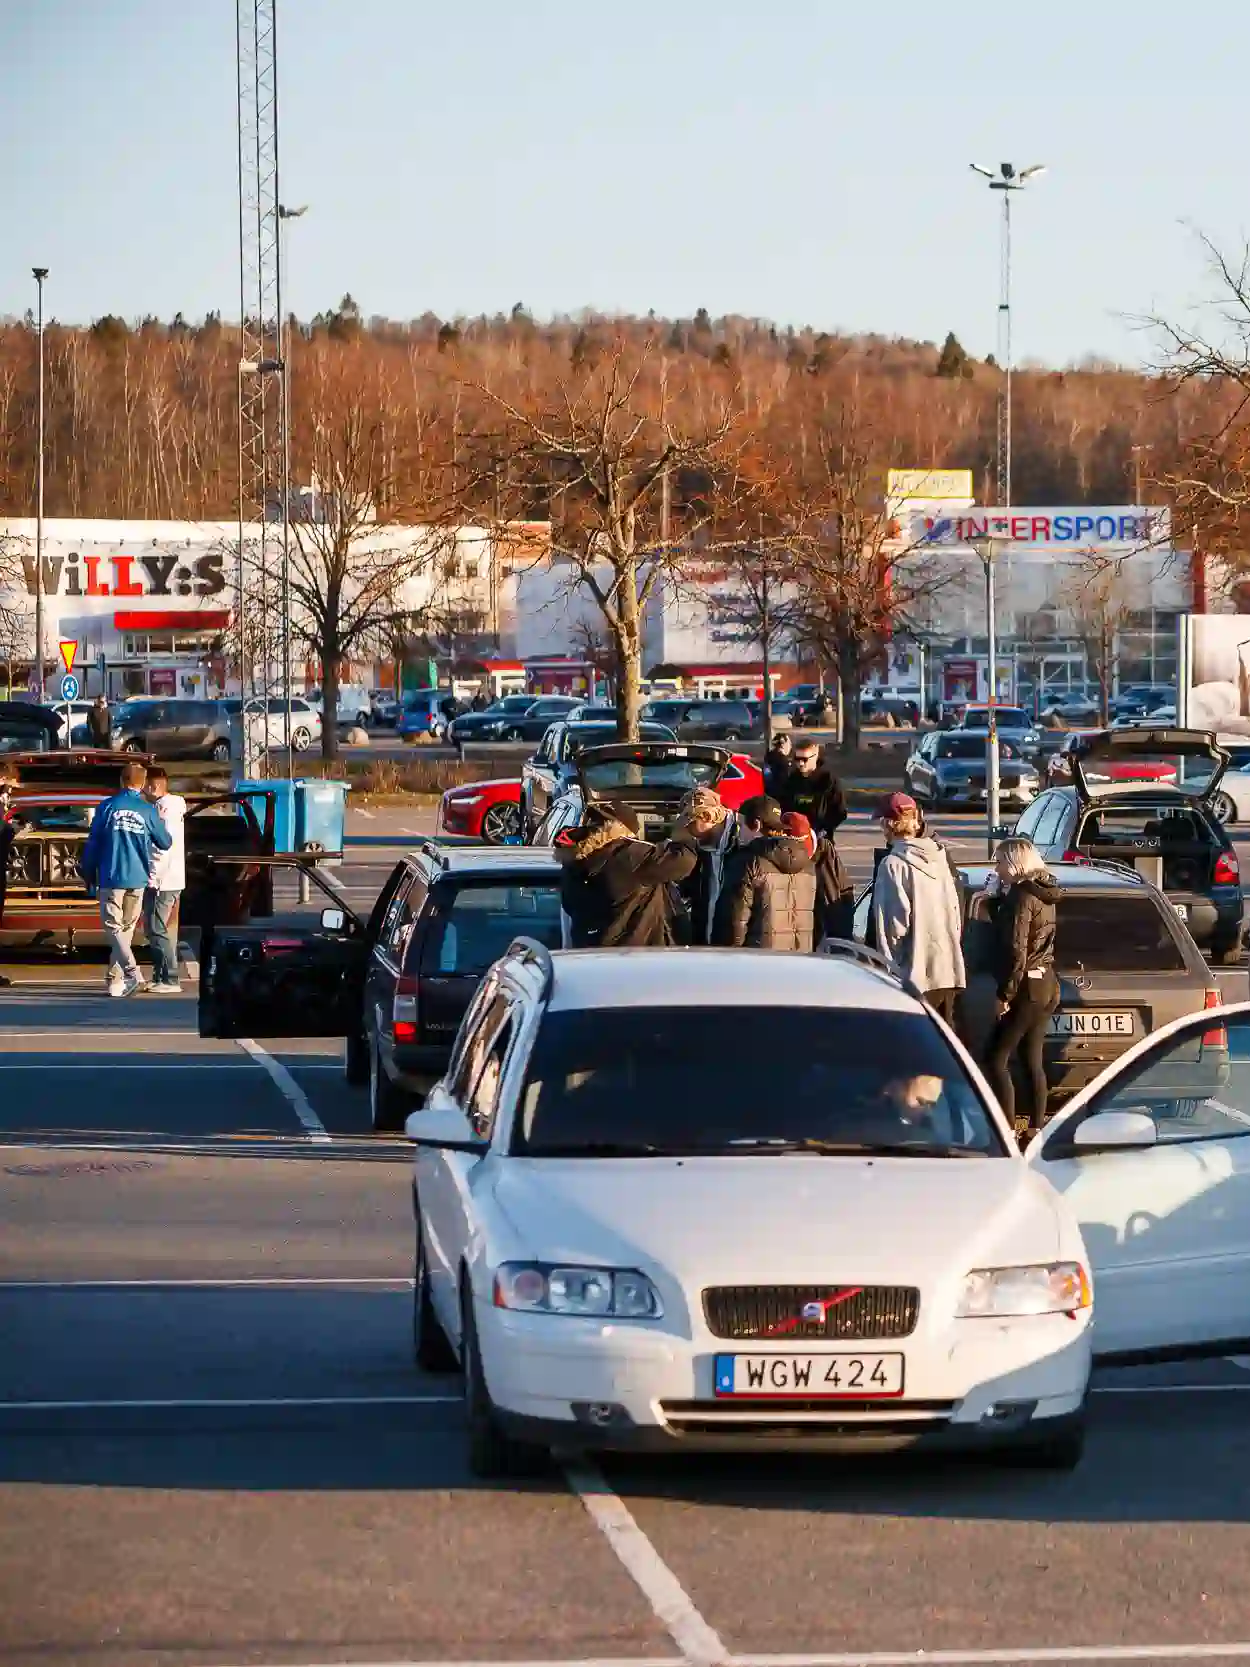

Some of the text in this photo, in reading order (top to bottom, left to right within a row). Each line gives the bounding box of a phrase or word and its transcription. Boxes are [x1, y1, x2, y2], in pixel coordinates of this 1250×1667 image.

[1051, 1015, 1125, 1031] YJN 01E
[747, 1359, 888, 1388] WGW 424
